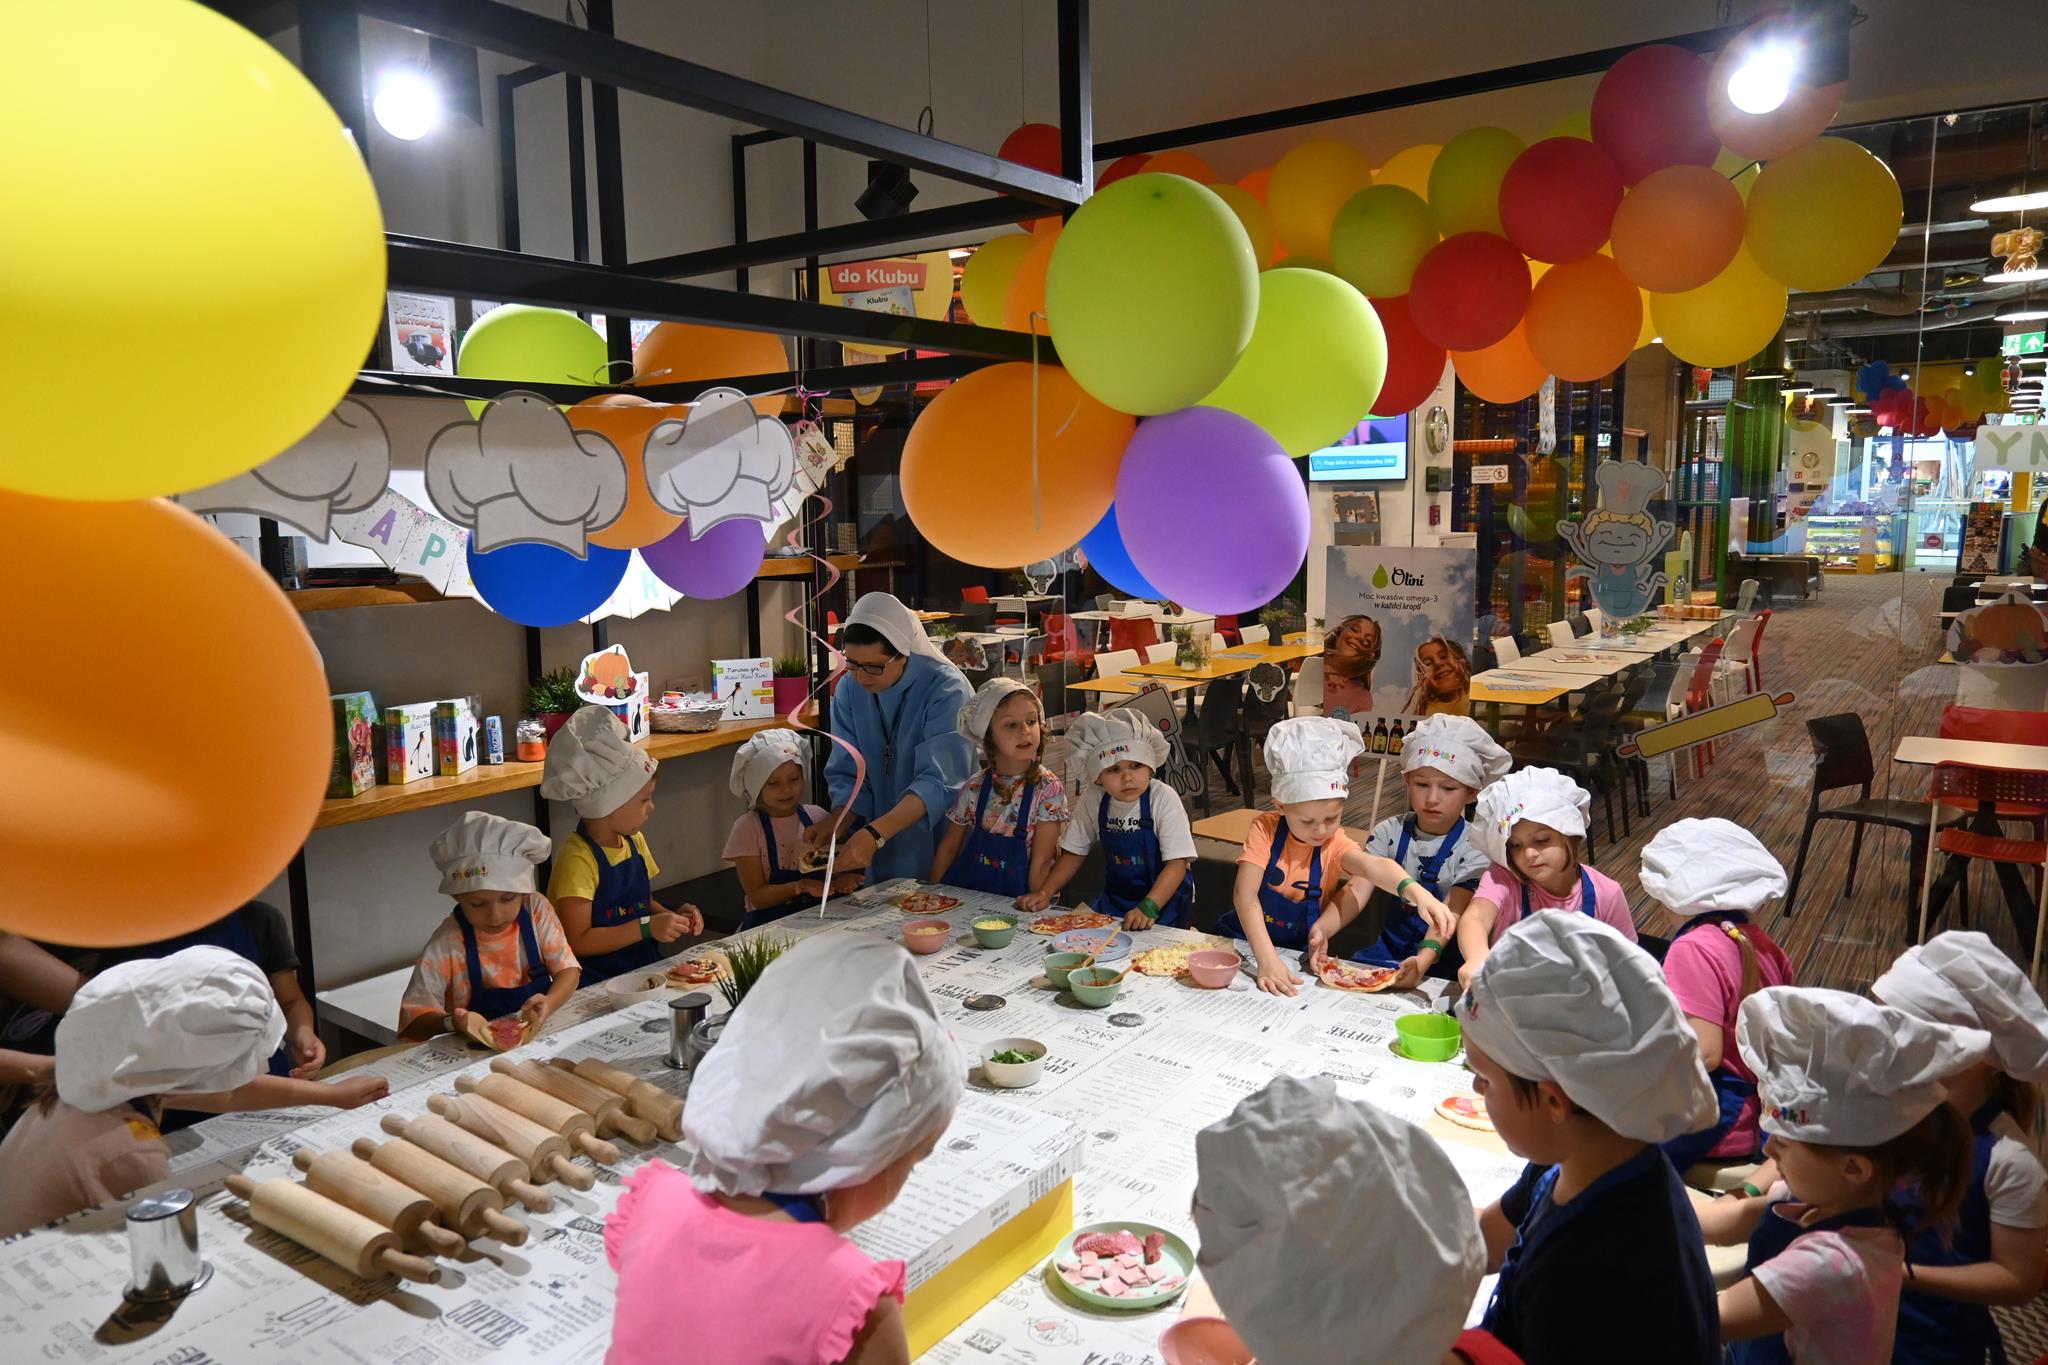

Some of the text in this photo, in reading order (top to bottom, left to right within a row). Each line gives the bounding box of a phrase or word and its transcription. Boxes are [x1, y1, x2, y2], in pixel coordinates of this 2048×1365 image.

[838, 268, 919, 285] do Klubu
[866, 296, 889, 305] Klubu
[1391, 566, 1424, 587] Olini
[1358, 592, 1438, 604] Moc kwasów omega-3
[1381, 602, 1402, 611] każdej
[1402, 602, 1422, 612] kropli
[1326, 1026, 1383, 1046] COFFEE
[445, 1299, 529, 1348] COFFEE
